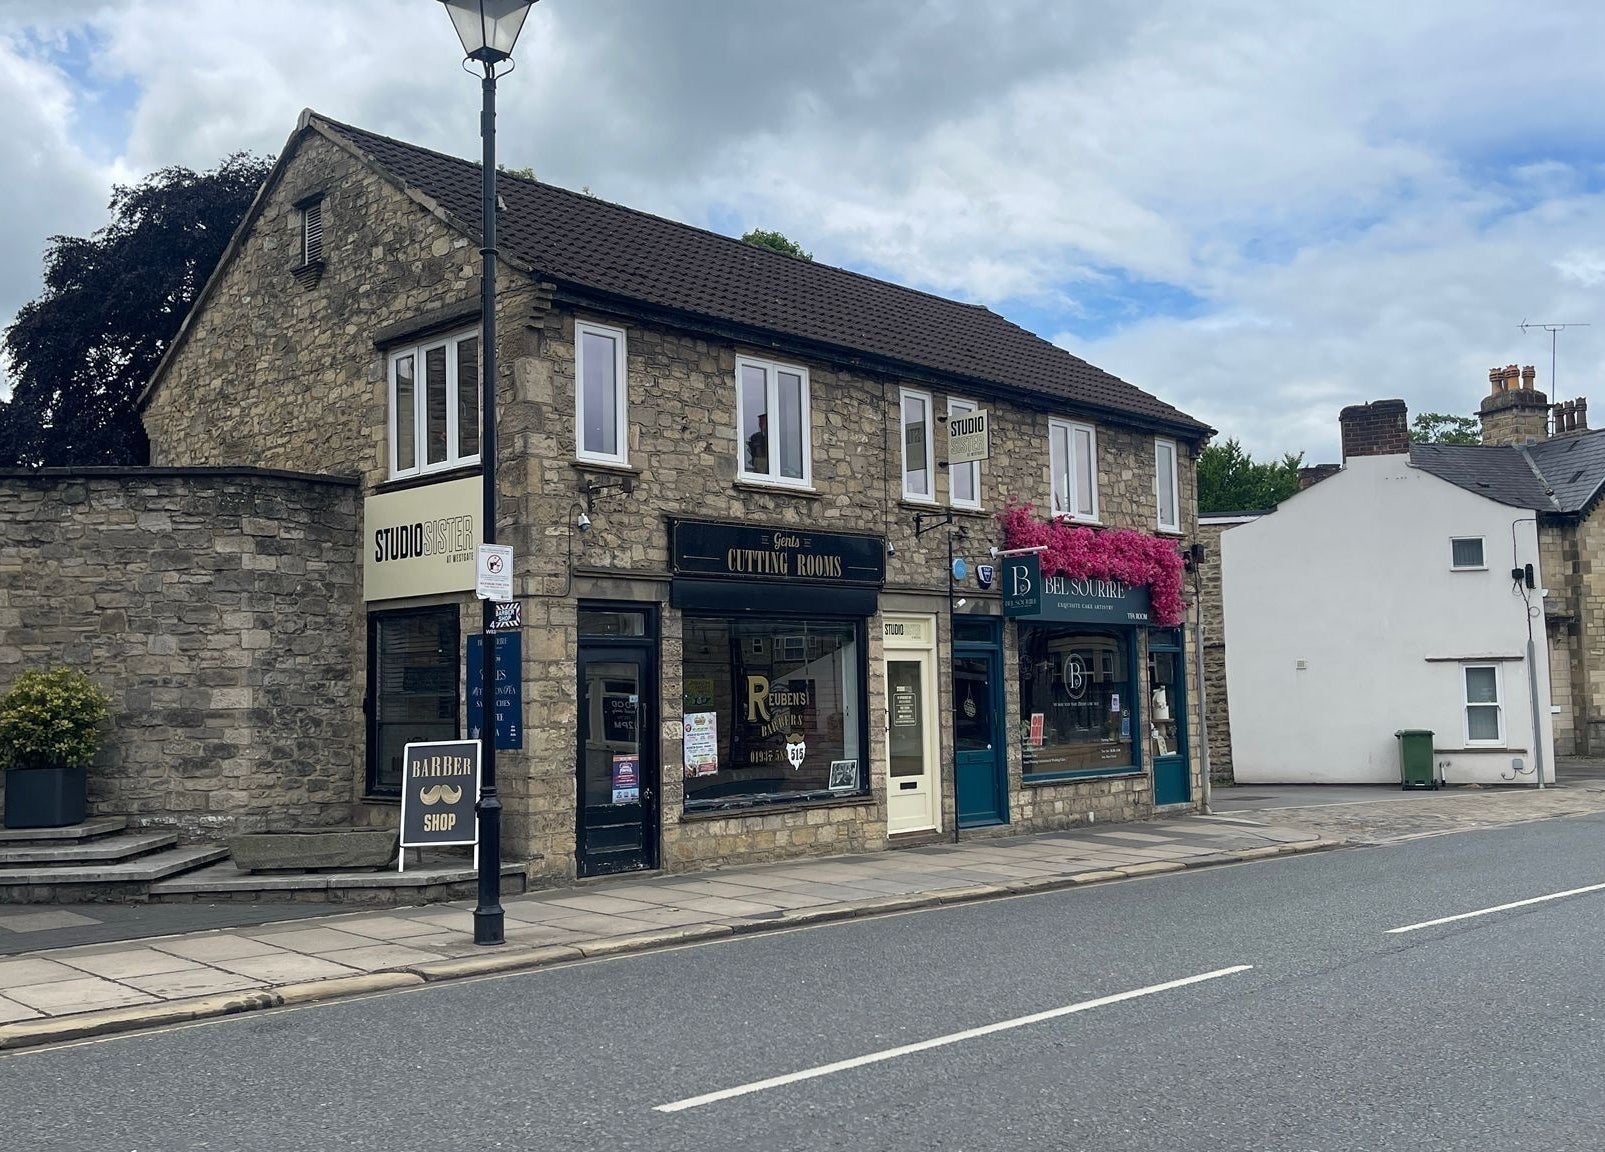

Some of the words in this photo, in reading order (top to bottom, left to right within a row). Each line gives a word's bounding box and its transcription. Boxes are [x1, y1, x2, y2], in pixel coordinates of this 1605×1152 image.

[951, 416, 984, 437] STUDIO
[773, 532, 800, 550] Gents
[452, 552, 474, 562] WESTGATE
[727, 548, 789, 575] CUTTING
[797, 553, 842, 578] ROOMS
[1011, 565, 1031, 597] B
[1044, 577, 1069, 596] BEL
[1071, 578, 1126, 599] SOURIRE
[747, 675, 806, 723] REUBEN'S
[790, 746, 804, 761] 515
[412, 756, 472, 778] BARBER
[423, 813, 457, 832] SHOP
